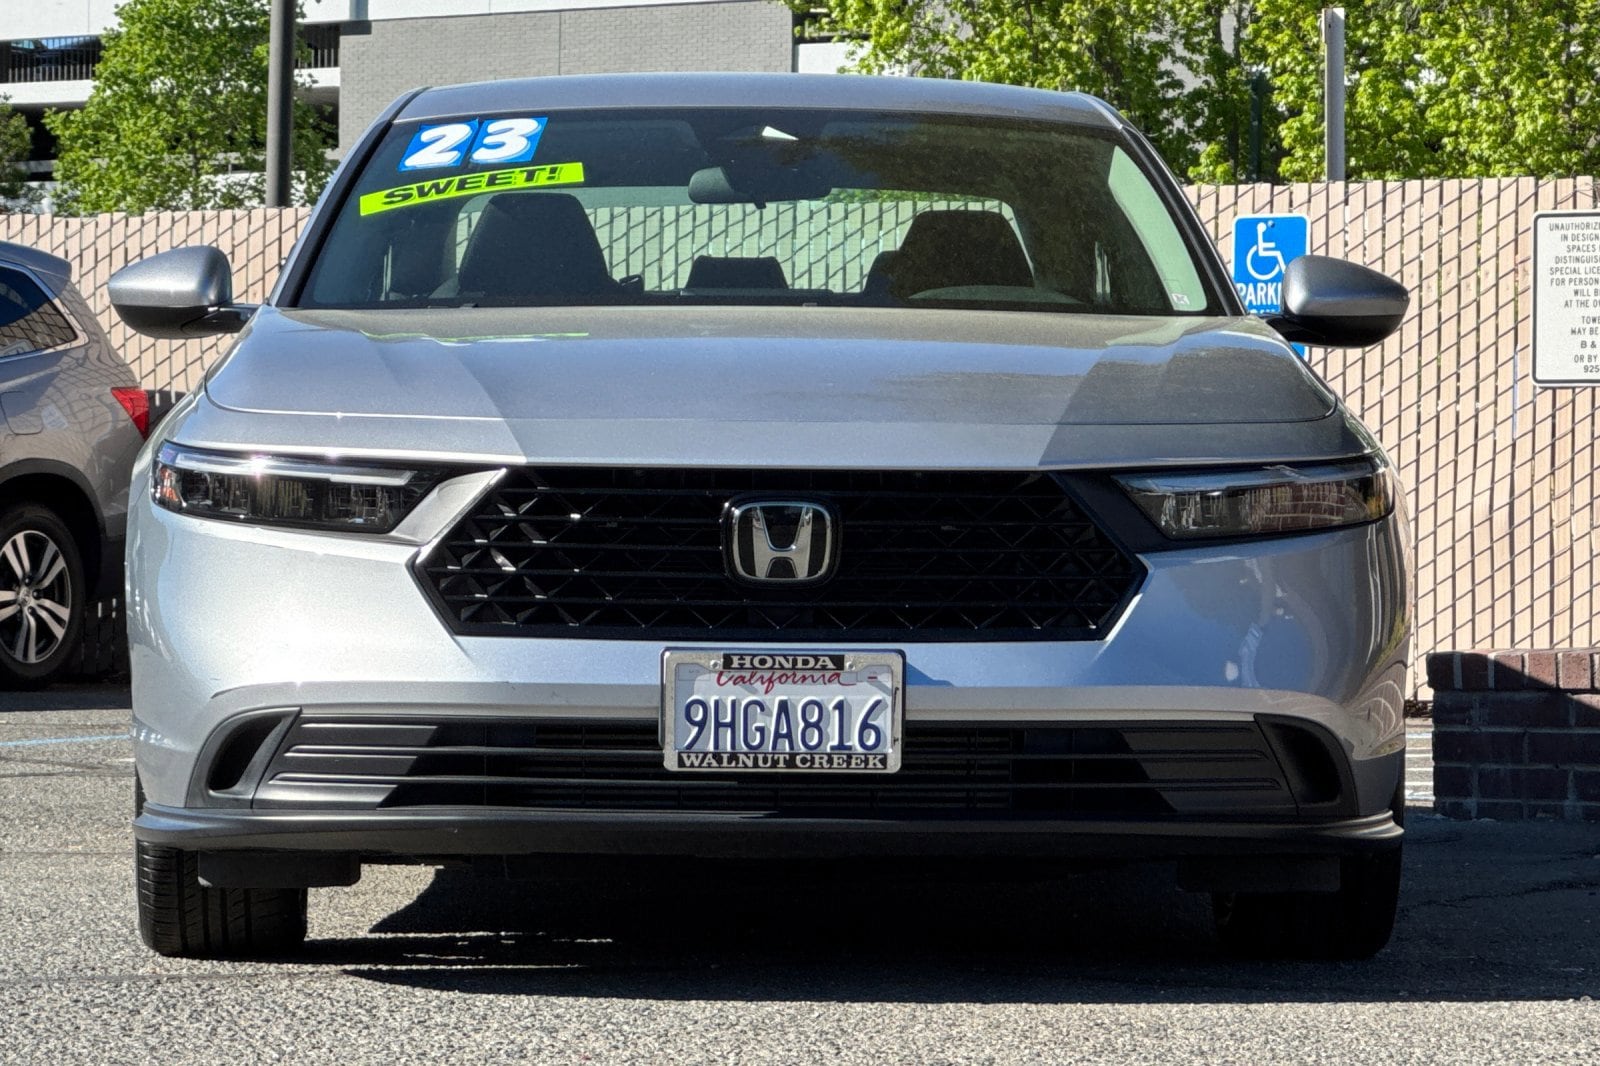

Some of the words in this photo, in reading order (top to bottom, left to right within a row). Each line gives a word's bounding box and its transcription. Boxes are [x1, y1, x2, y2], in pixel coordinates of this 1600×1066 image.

[403, 117, 542, 169] 23
[381, 166, 564, 206] SWEET!
[1560, 233, 1568, 242] IN
[1566, 244, 1597, 253] SPACES
[1549, 266, 1581, 276] SPECIAL
[1550, 277, 1566, 287] FOR
[1573, 288, 1591, 297] WILL
[1564, 300, 1573, 308] AT
[1576, 299, 1590, 308] THE
[1570, 327, 1586, 336] MAY
[1589, 326, 1599, 336] BE
[1580, 340, 1588, 349] B
[1573, 354, 1585, 363] OR
[1587, 354, 1598, 363] BY
[730, 655, 836, 669] HONDA
[716, 671, 857, 695] California
[683, 698, 884, 751] 9HGA816
[681, 753, 789, 769] WALNUT
[795, 753, 885, 769] CREEK
